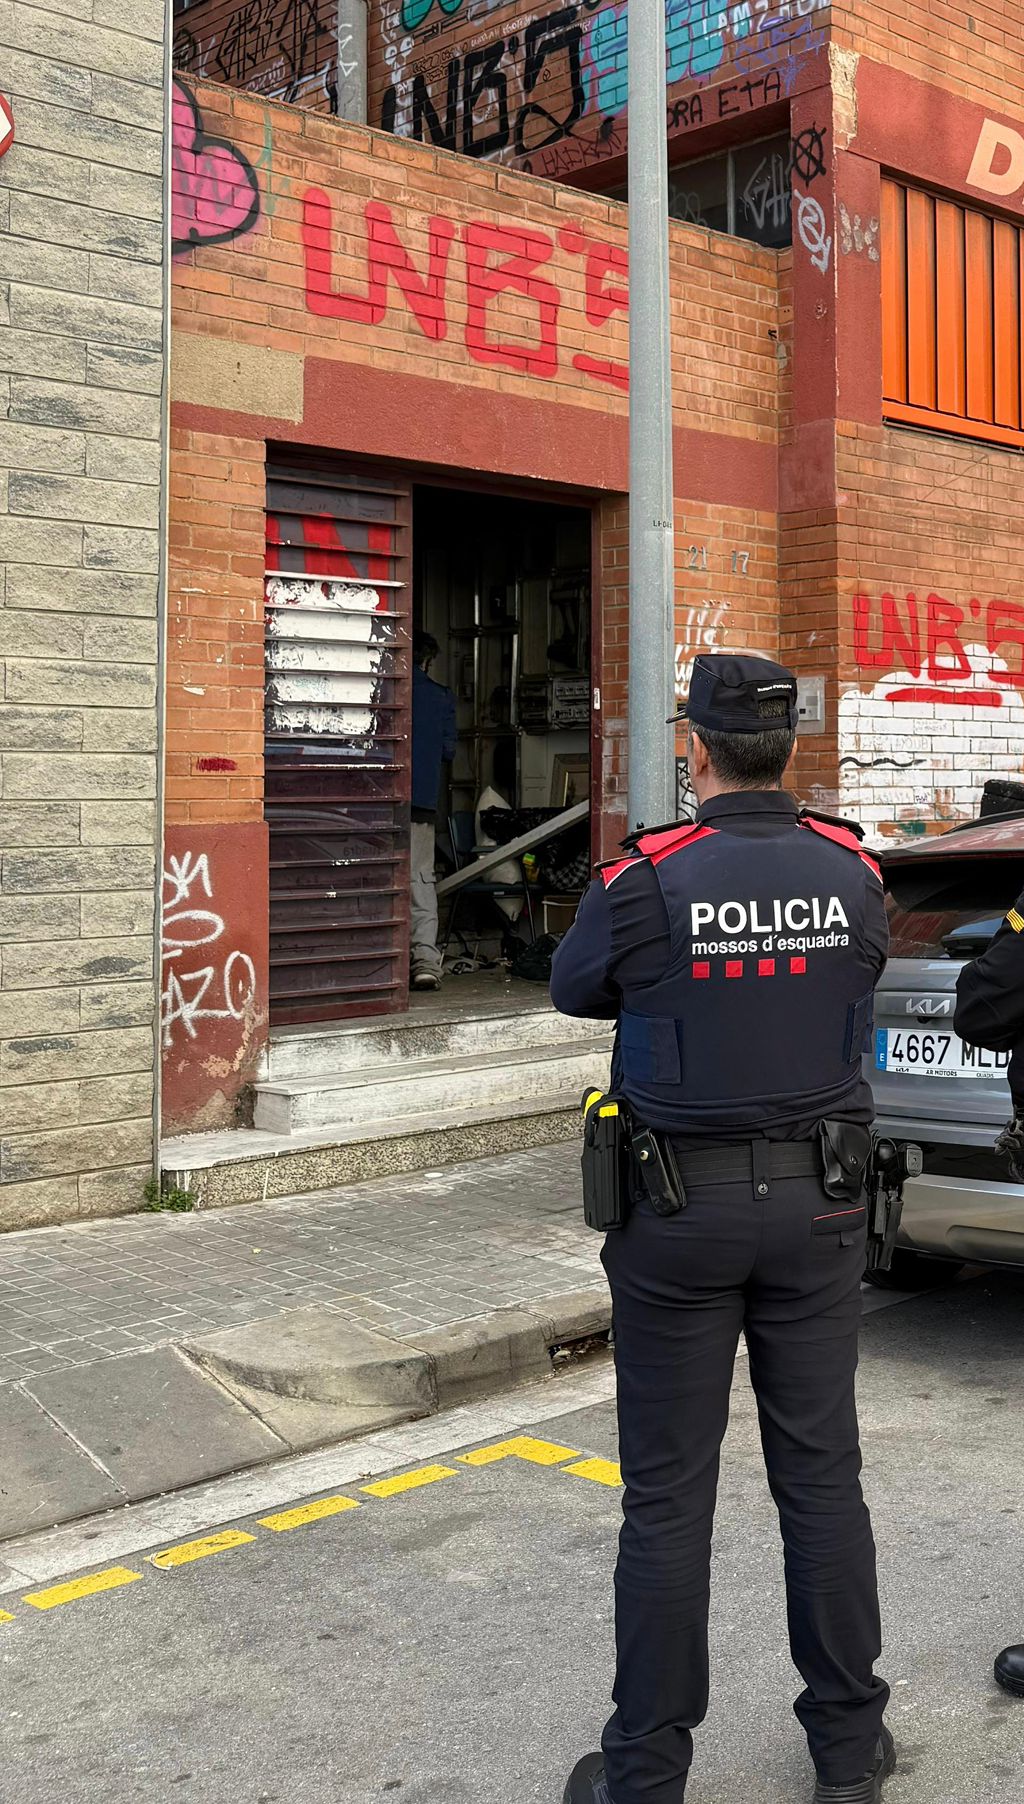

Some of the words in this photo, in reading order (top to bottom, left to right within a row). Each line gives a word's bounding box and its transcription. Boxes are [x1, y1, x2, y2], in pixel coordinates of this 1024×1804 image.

[718, 68, 780, 117] ETA
[687, 545, 707, 570] 21
[731, 549, 750, 574] 17
[691, 897, 849, 936] POLICIA
[692, 940, 757, 955] mossos
[905, 998, 951, 1015] KIA
[879, 1053, 885, 1062] E
[892, 1033, 952, 1065] 4667
